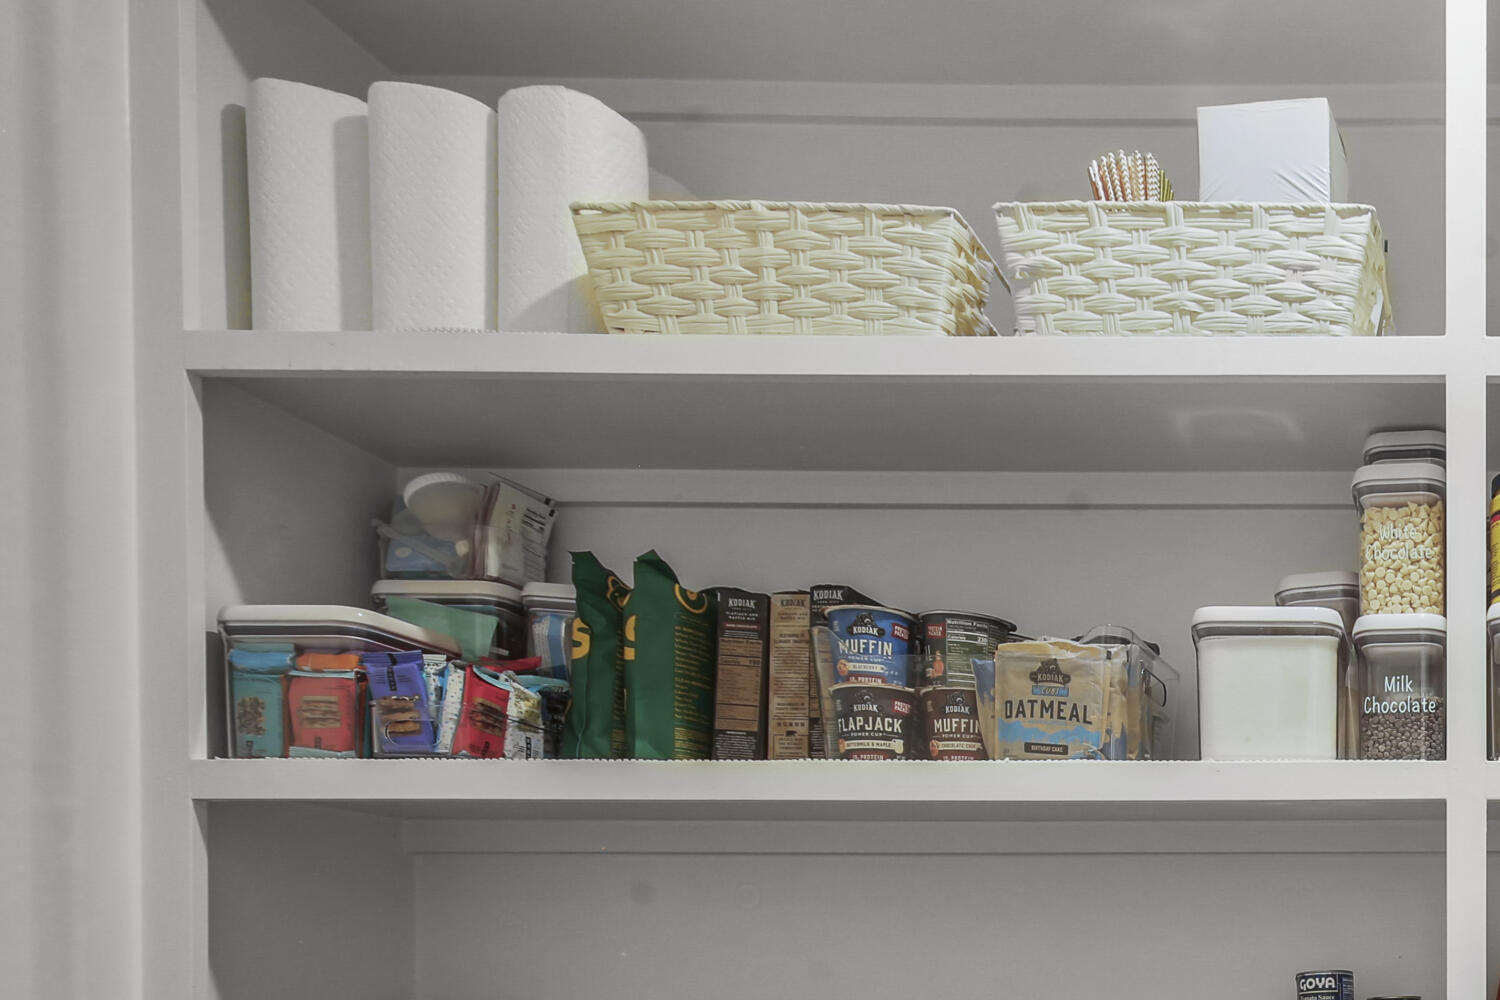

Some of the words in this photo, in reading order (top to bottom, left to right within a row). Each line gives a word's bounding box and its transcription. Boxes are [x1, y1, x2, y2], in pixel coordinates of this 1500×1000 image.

[1379, 524, 1417, 540] White
[1365, 544, 1433, 561] Chocolate
[813, 590, 844, 600] KODIAK
[728, 598, 755, 608] KODIAK
[852, 626, 878, 636] KODIAK
[838, 639, 893, 656] MUFFIN
[1036, 673, 1064, 683] KODIAK
[1385, 675, 1413, 692] Milk
[853, 703, 878, 712] KODIAK
[945, 705, 970, 715] KODIAK
[1004, 699, 1093, 725] OATMEAL
[1364, 696, 1436, 713] Chocolate
[837, 717, 902, 733] FLAPJACK
[1300, 977, 1336, 991] GOYA
